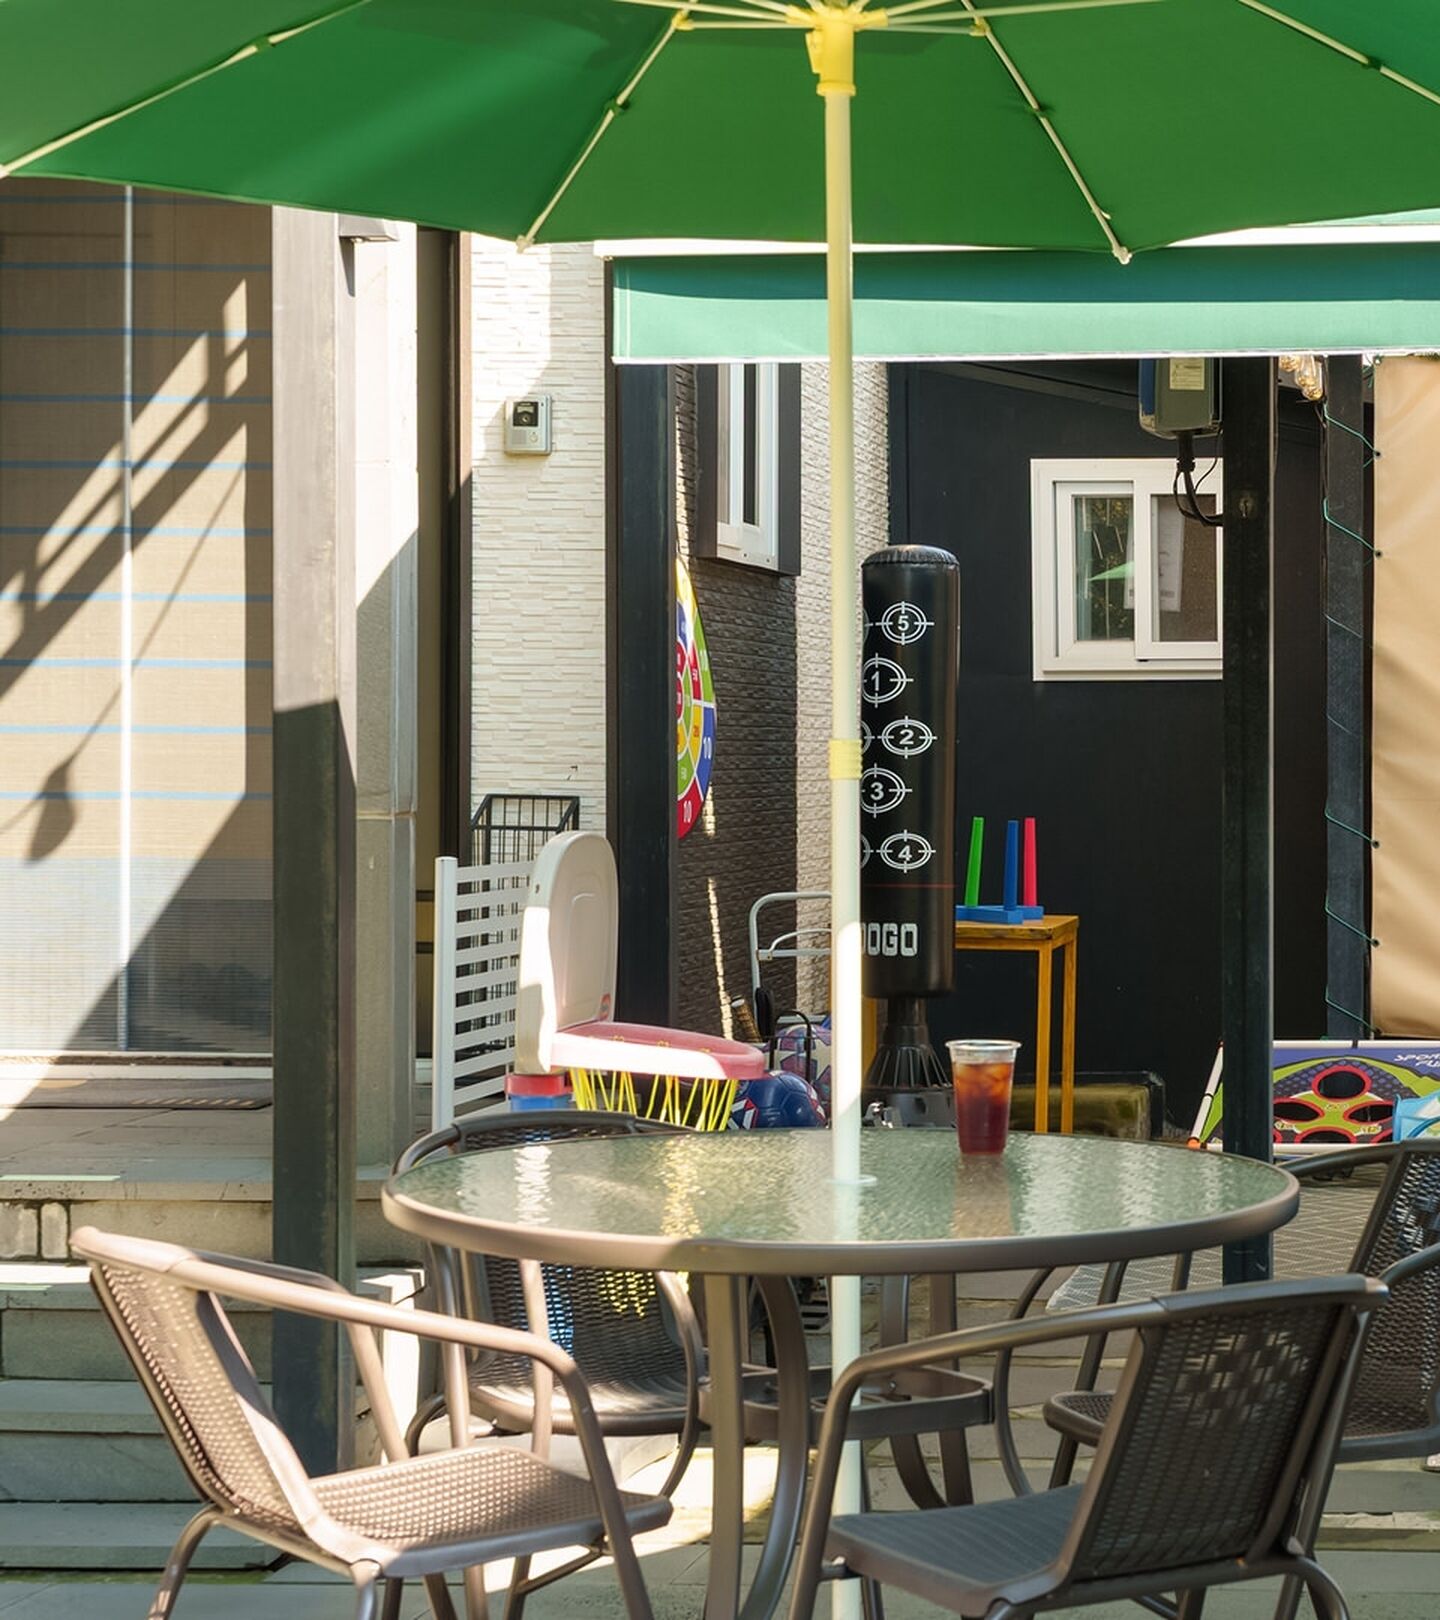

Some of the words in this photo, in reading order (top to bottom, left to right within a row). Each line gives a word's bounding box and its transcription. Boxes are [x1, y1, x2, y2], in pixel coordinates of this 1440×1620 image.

[897, 615, 910, 632] 5
[871, 671, 880, 691] 1
[899, 729, 914, 745] 2
[870, 782, 884, 800] 3
[898, 845, 913, 861] 4
